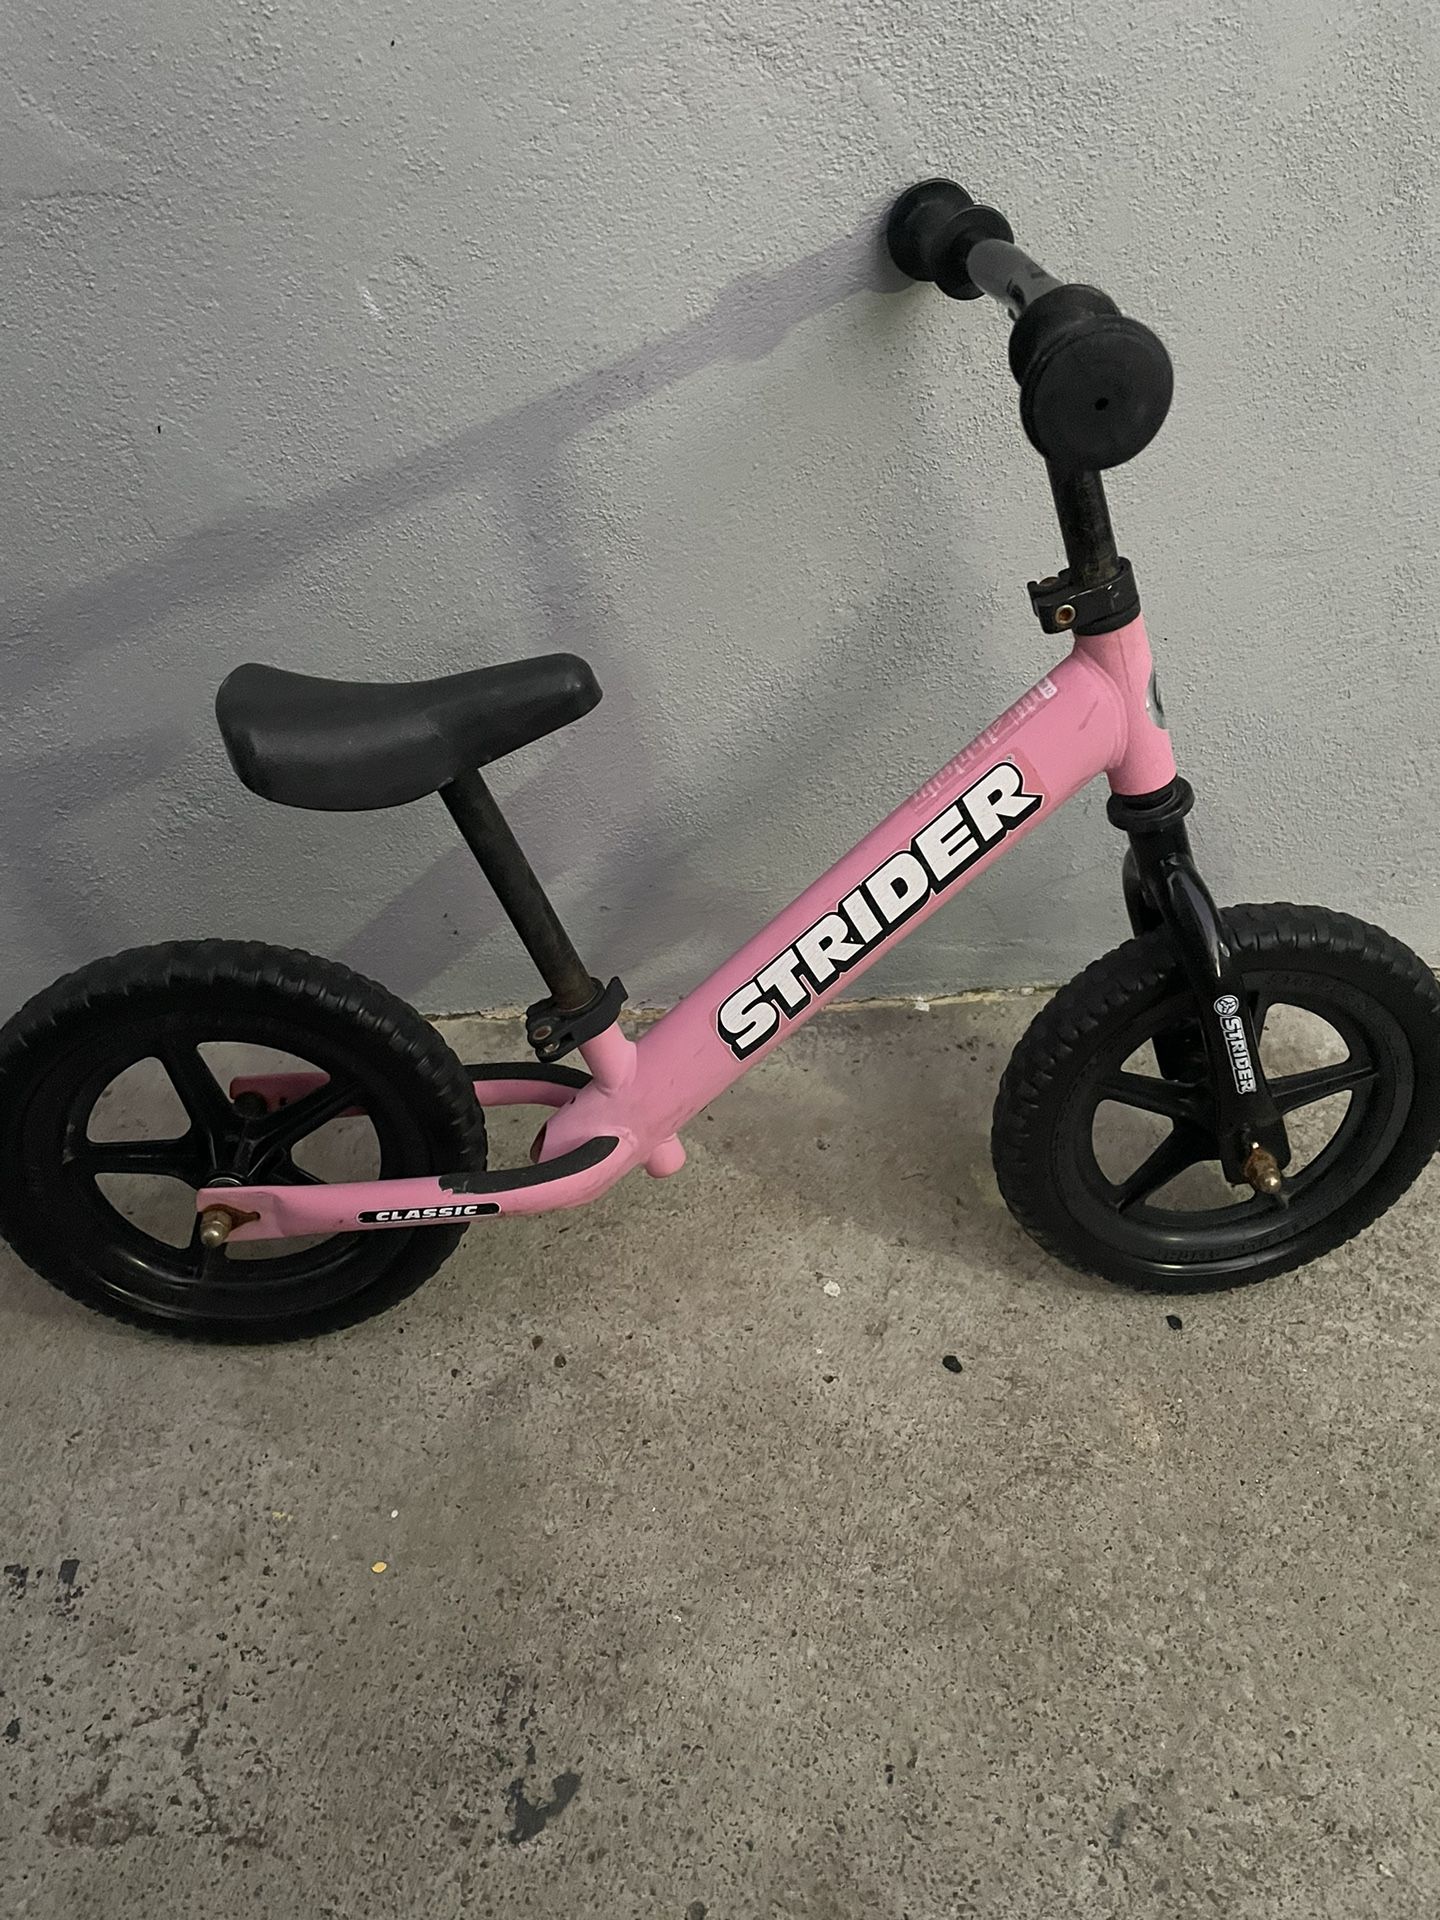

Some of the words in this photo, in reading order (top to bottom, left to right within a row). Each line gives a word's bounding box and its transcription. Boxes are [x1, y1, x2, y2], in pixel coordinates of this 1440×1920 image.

[717, 762, 1042, 1058] STRIDER
[1222, 1017, 1256, 1093] STRIDER
[375, 1205, 478, 1222] CLASSIC
